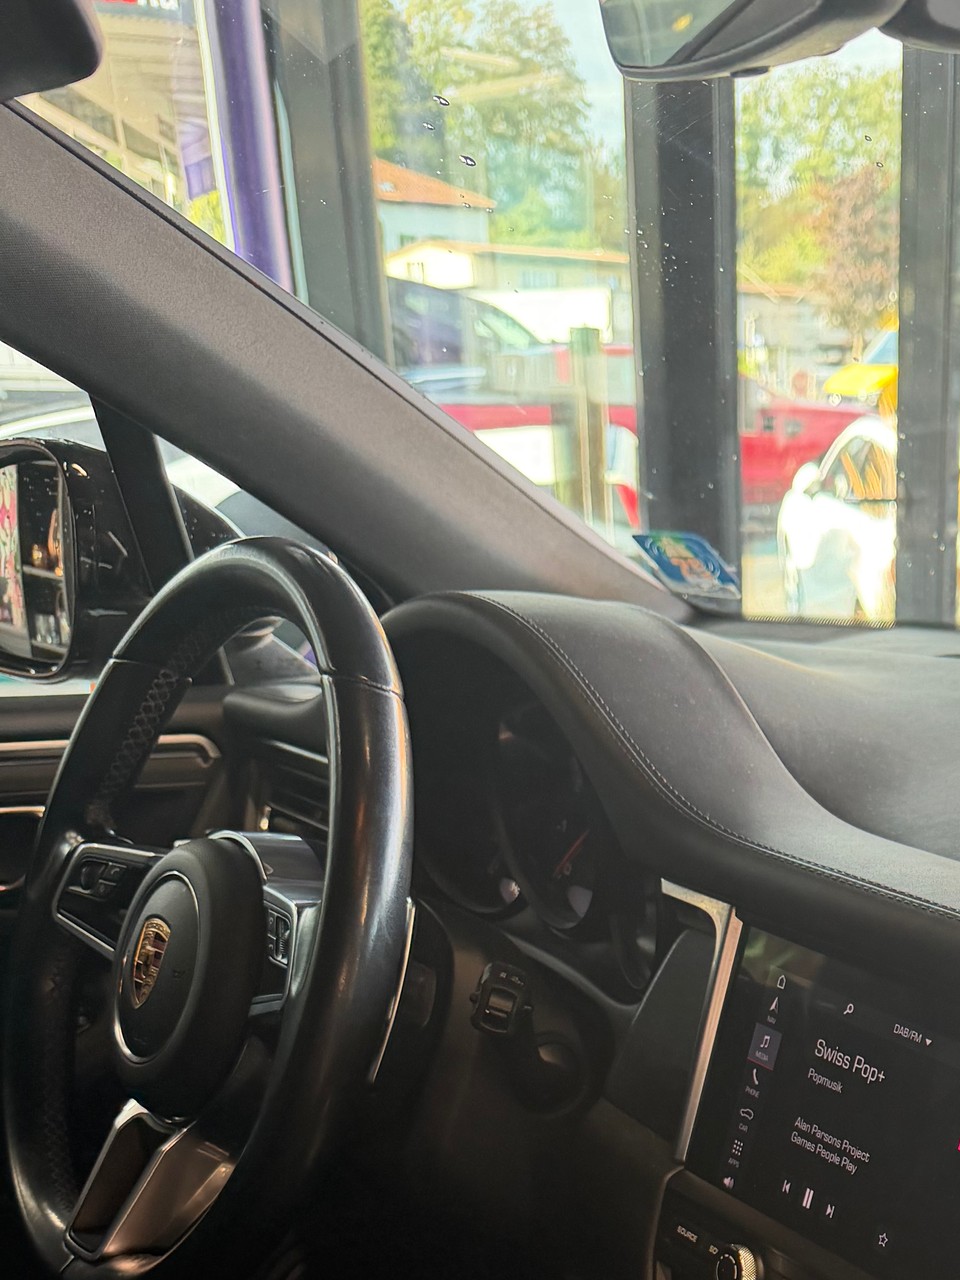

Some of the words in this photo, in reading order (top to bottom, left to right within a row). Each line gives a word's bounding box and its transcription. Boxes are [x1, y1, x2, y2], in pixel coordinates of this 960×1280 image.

[893, 1023, 922, 1044] DAB/FM
[815, 1039, 851, 1070] Swiss
[852, 1055, 886, 1084] Pop+
[807, 1067, 844, 1094] Popmusik
[791, 1131, 816, 1152] Games
[815, 1143, 841, 1166] People
[840, 1156, 858, 1175] Play
[795, 1117, 811, 1134] Alan
[811, 1124, 842, 1149] Parsons
[841, 1140, 871, 1163] Project
[676, 1225, 698, 1243] SOURCE
